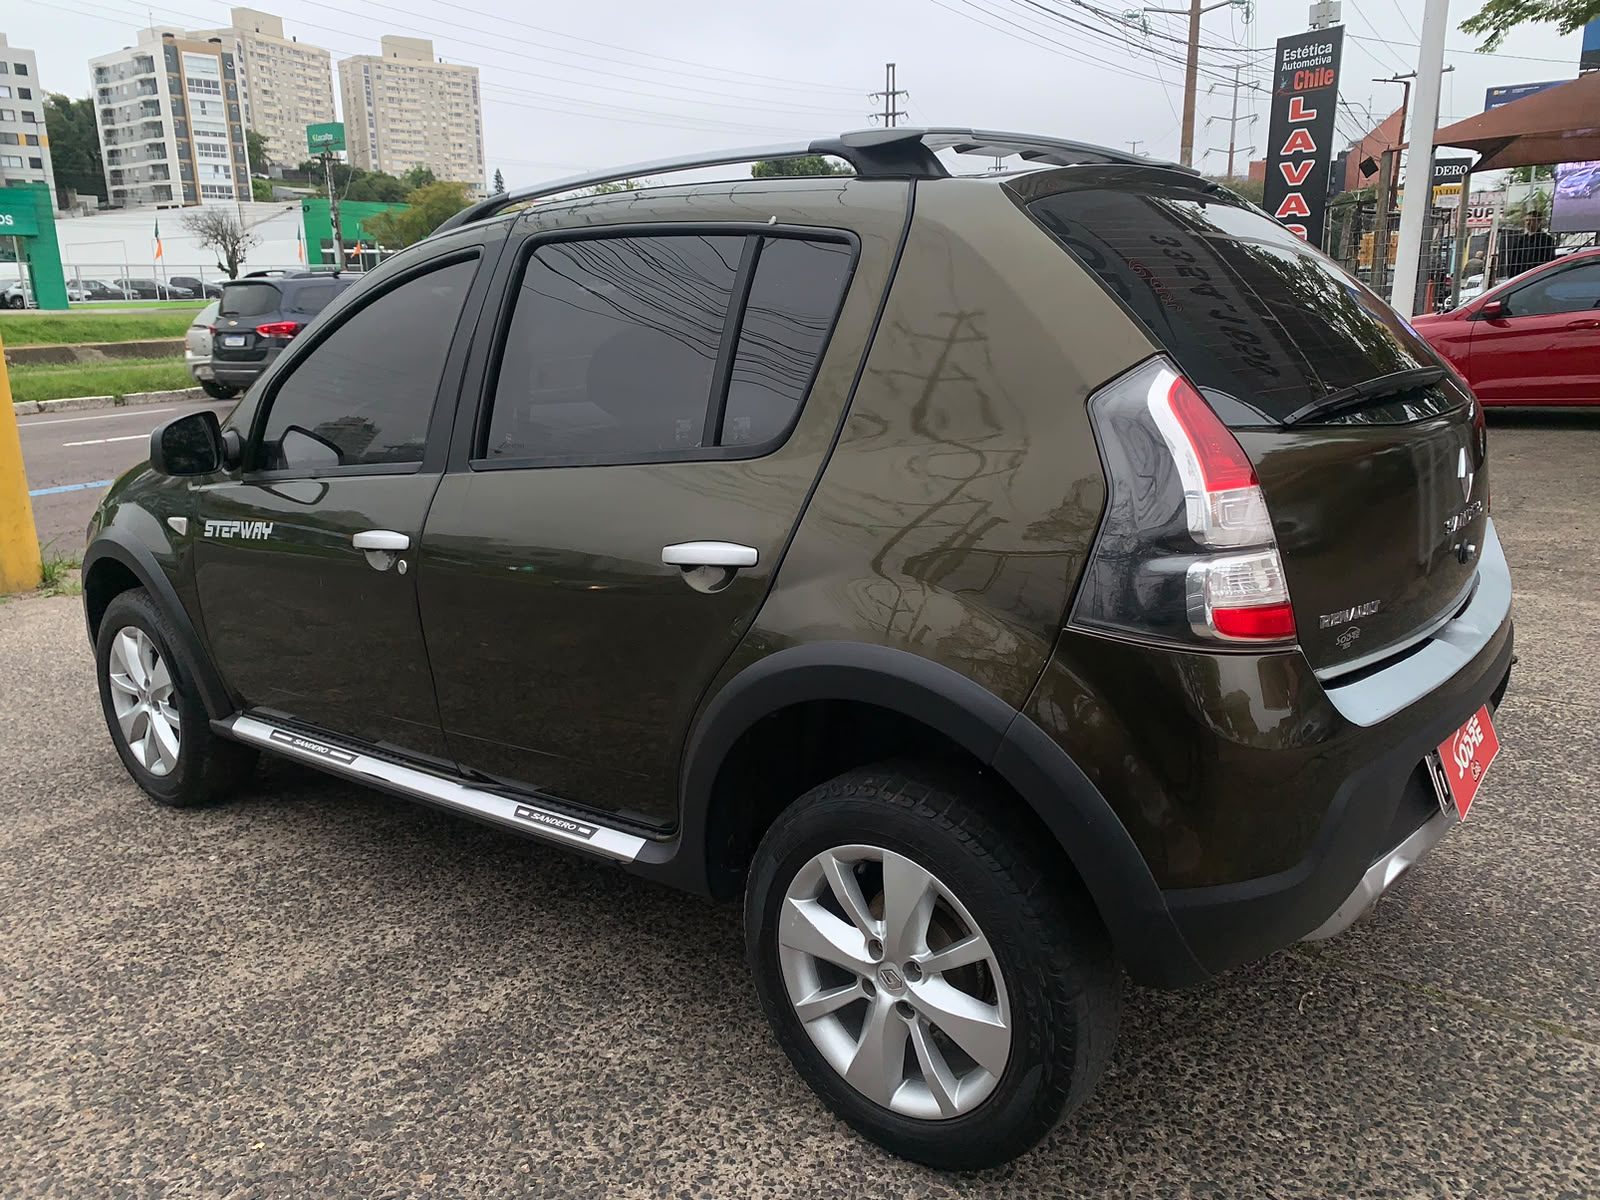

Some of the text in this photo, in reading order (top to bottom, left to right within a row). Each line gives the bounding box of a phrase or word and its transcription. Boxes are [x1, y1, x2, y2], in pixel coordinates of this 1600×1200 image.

[1282, 43, 1333, 62] Estética
[1281, 55, 1332, 72] Automotiva
[1293, 66, 1335, 91] Chile
[203, 519, 274, 540] STEPWAY
[1319, 599, 1381, 629] RENAULT
[293, 738, 329, 754] SANDERO
[530, 812, 577, 830] SANDERO
